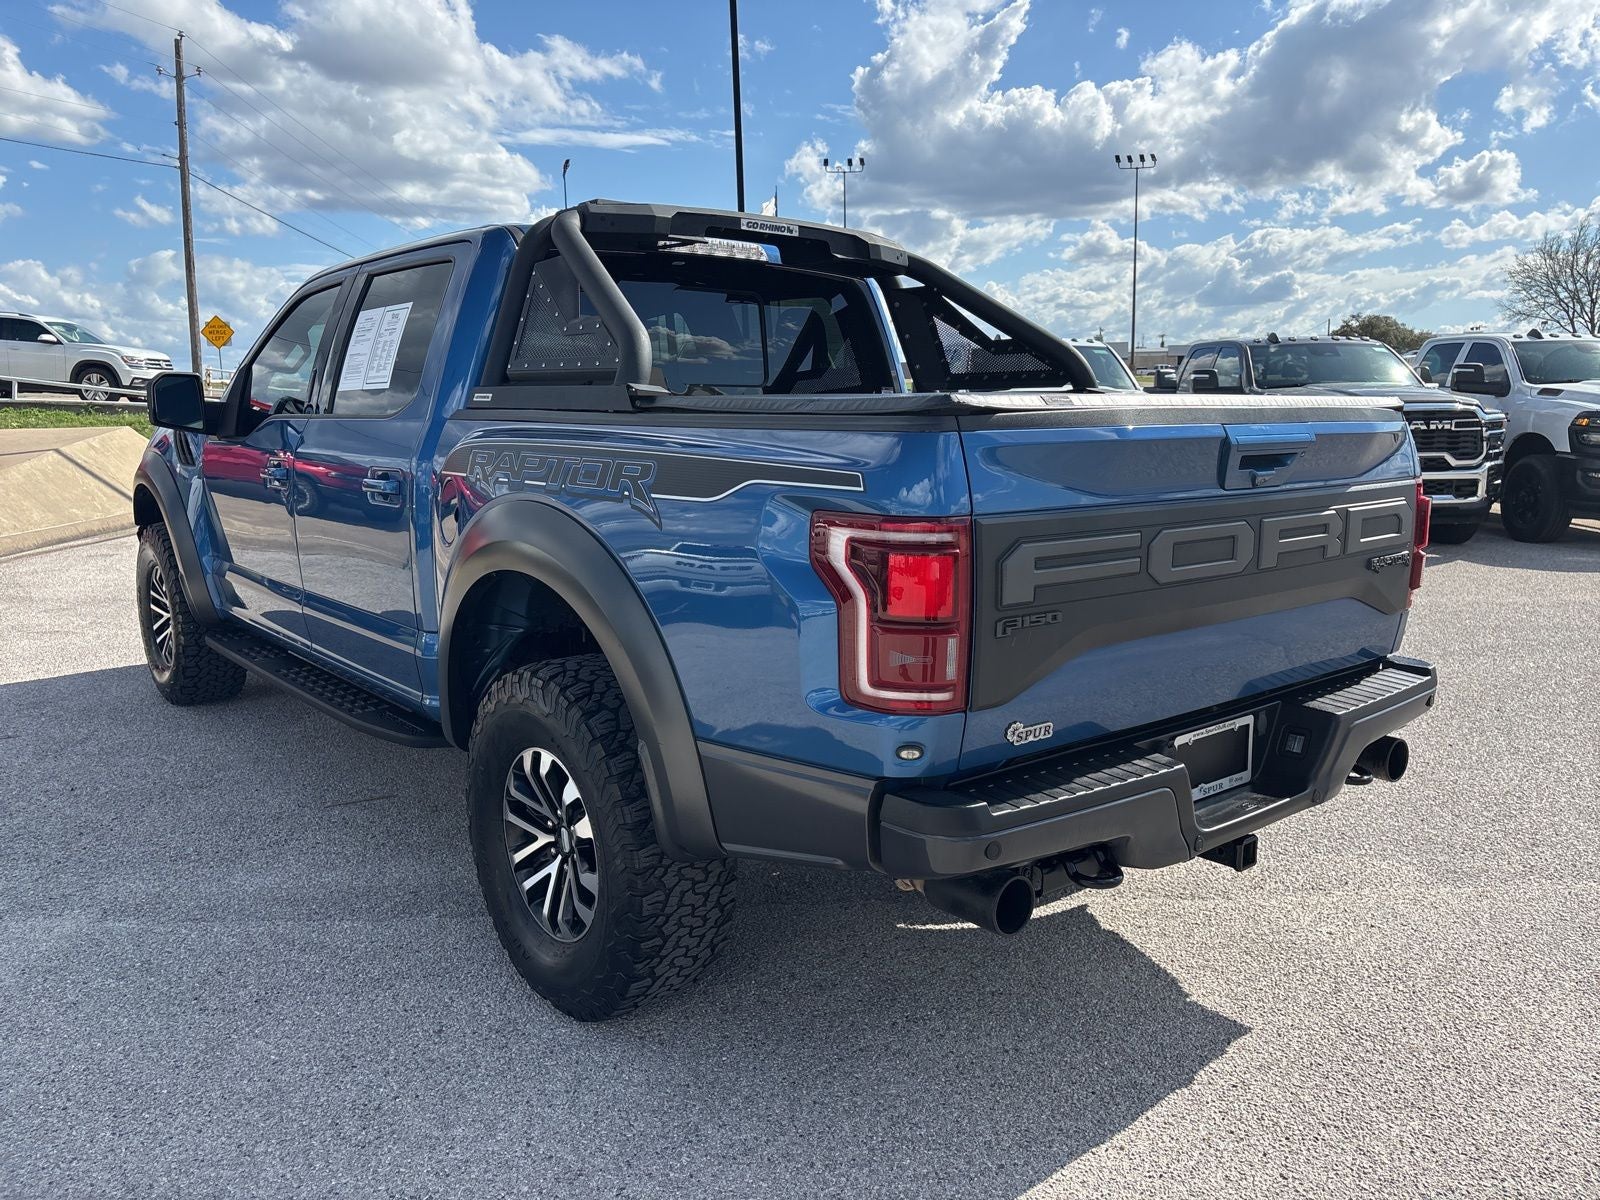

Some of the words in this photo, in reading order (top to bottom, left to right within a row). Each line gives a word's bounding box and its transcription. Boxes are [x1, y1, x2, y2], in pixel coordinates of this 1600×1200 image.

[746, 221, 759, 229] GO
[759, 223, 786, 233] RHINO
[1410, 420, 1452, 430] AM
[466, 449, 662, 530] RAPTOR
[1001, 500, 1413, 606] FORD
[1370, 551, 1410, 573] RAPTOR
[1016, 725, 1051, 743] SPUR
[1202, 782, 1224, 796] SPUR
